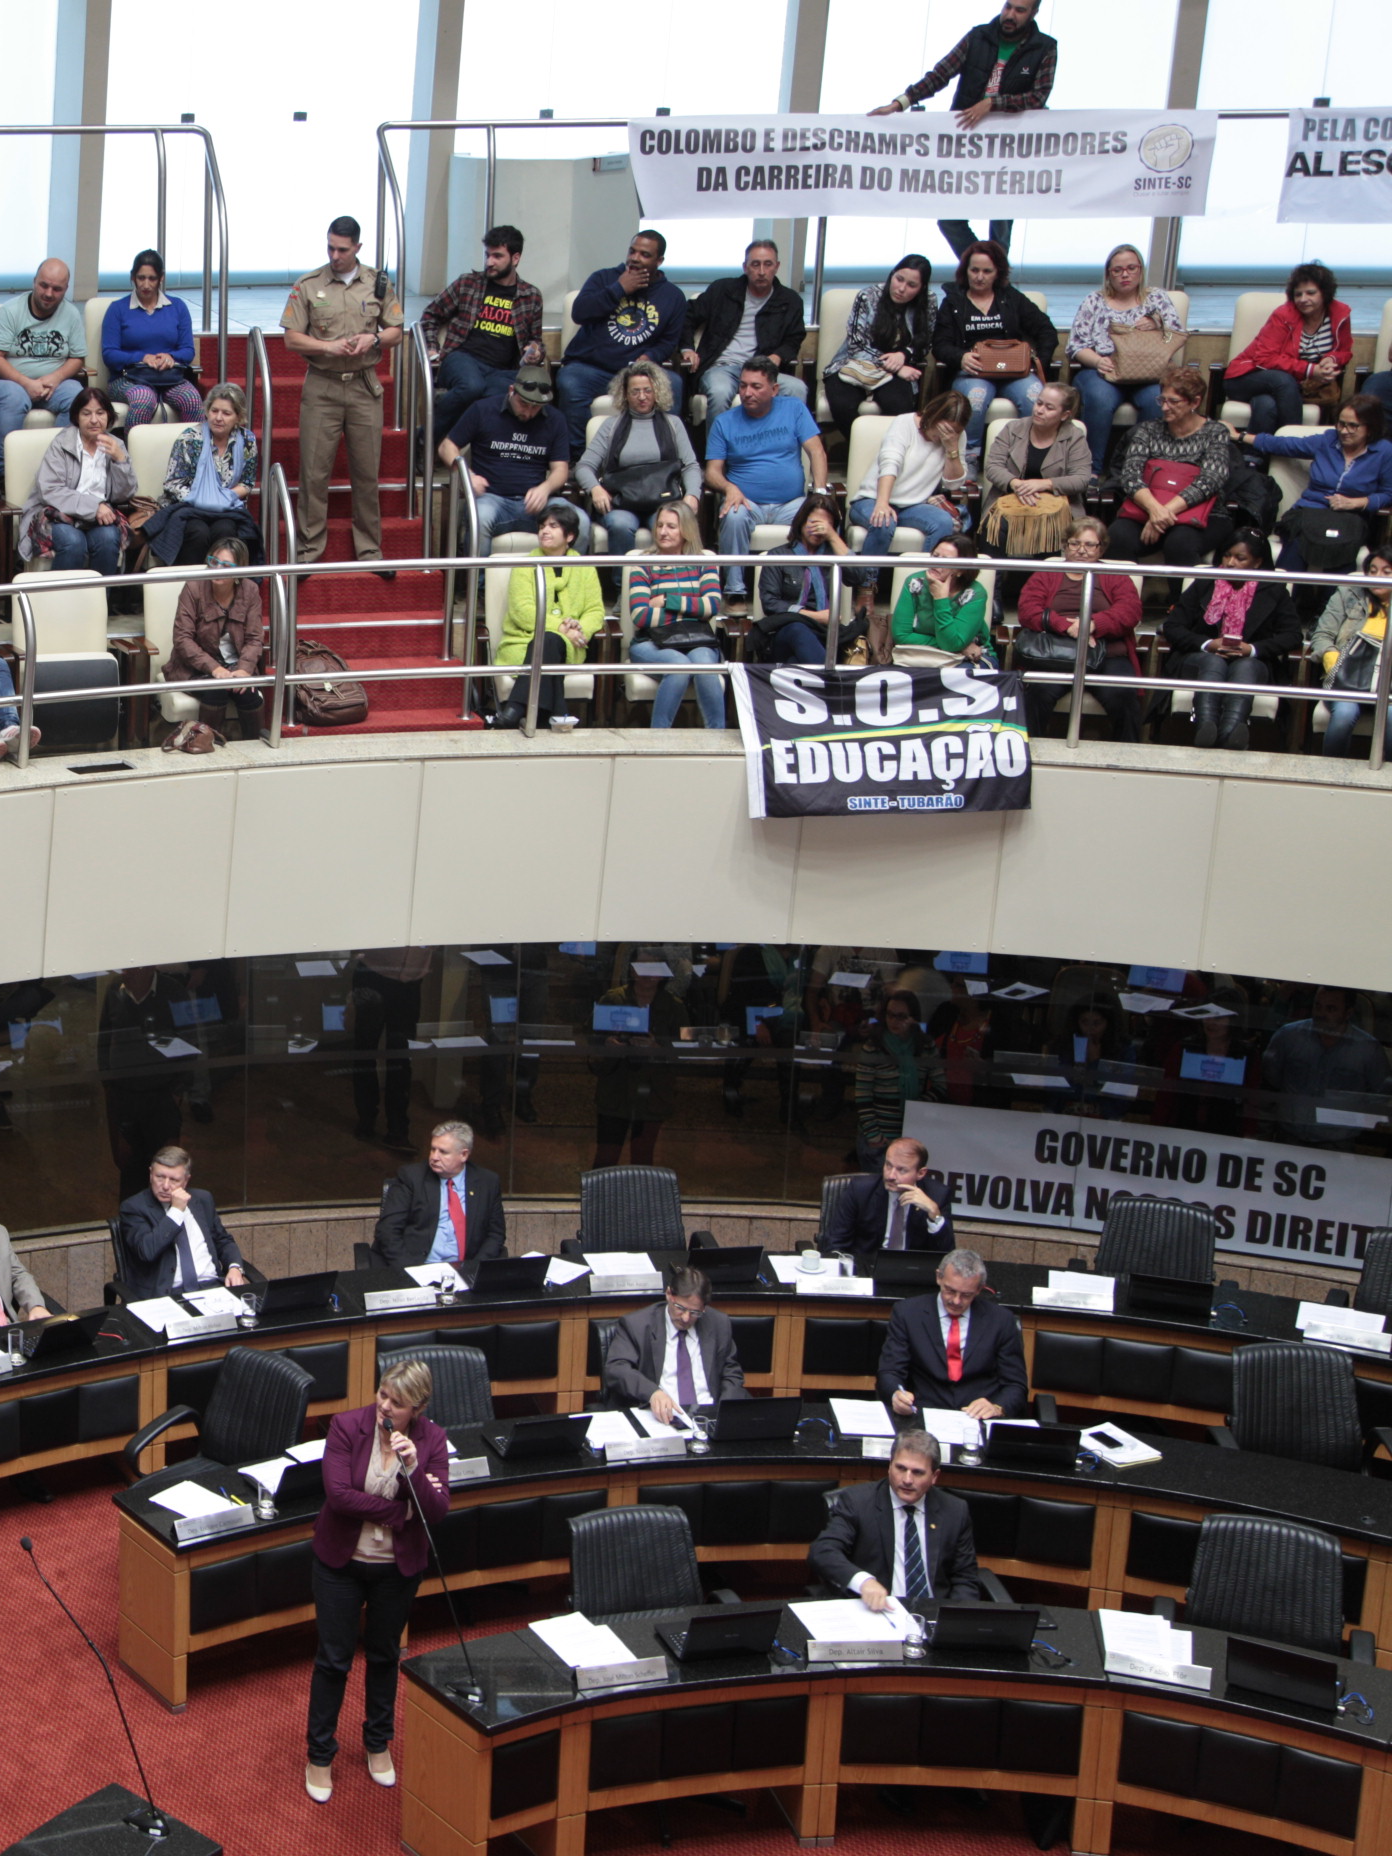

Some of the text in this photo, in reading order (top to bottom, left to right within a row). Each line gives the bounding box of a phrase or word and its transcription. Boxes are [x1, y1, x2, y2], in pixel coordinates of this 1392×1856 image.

[1302, 118, 1356, 142] PELA
[640, 128, 1128, 159] COLOMBO E DESCHAMPS DESTRUIDORES
[1285, 149, 1392, 178] ALES
[696, 164, 1062, 195] DA CARREIRA DO MAGISTÉRIO!
[1134, 176, 1192, 190] SINTE-SC
[608, 321, 652, 345] CALIFORNIA
[965, 323, 976, 331] DA
[490, 441, 547, 455] INDEPENDENTE
[512, 432, 528, 442] SOU
[770, 668, 1017, 726] S.O.S.
[770, 723, 1027, 790] EDUCAÇÃO
[1034, 1128, 1326, 1200] GOVERNO DE SC
[1129, 1663, 1146, 1673] Dep.
